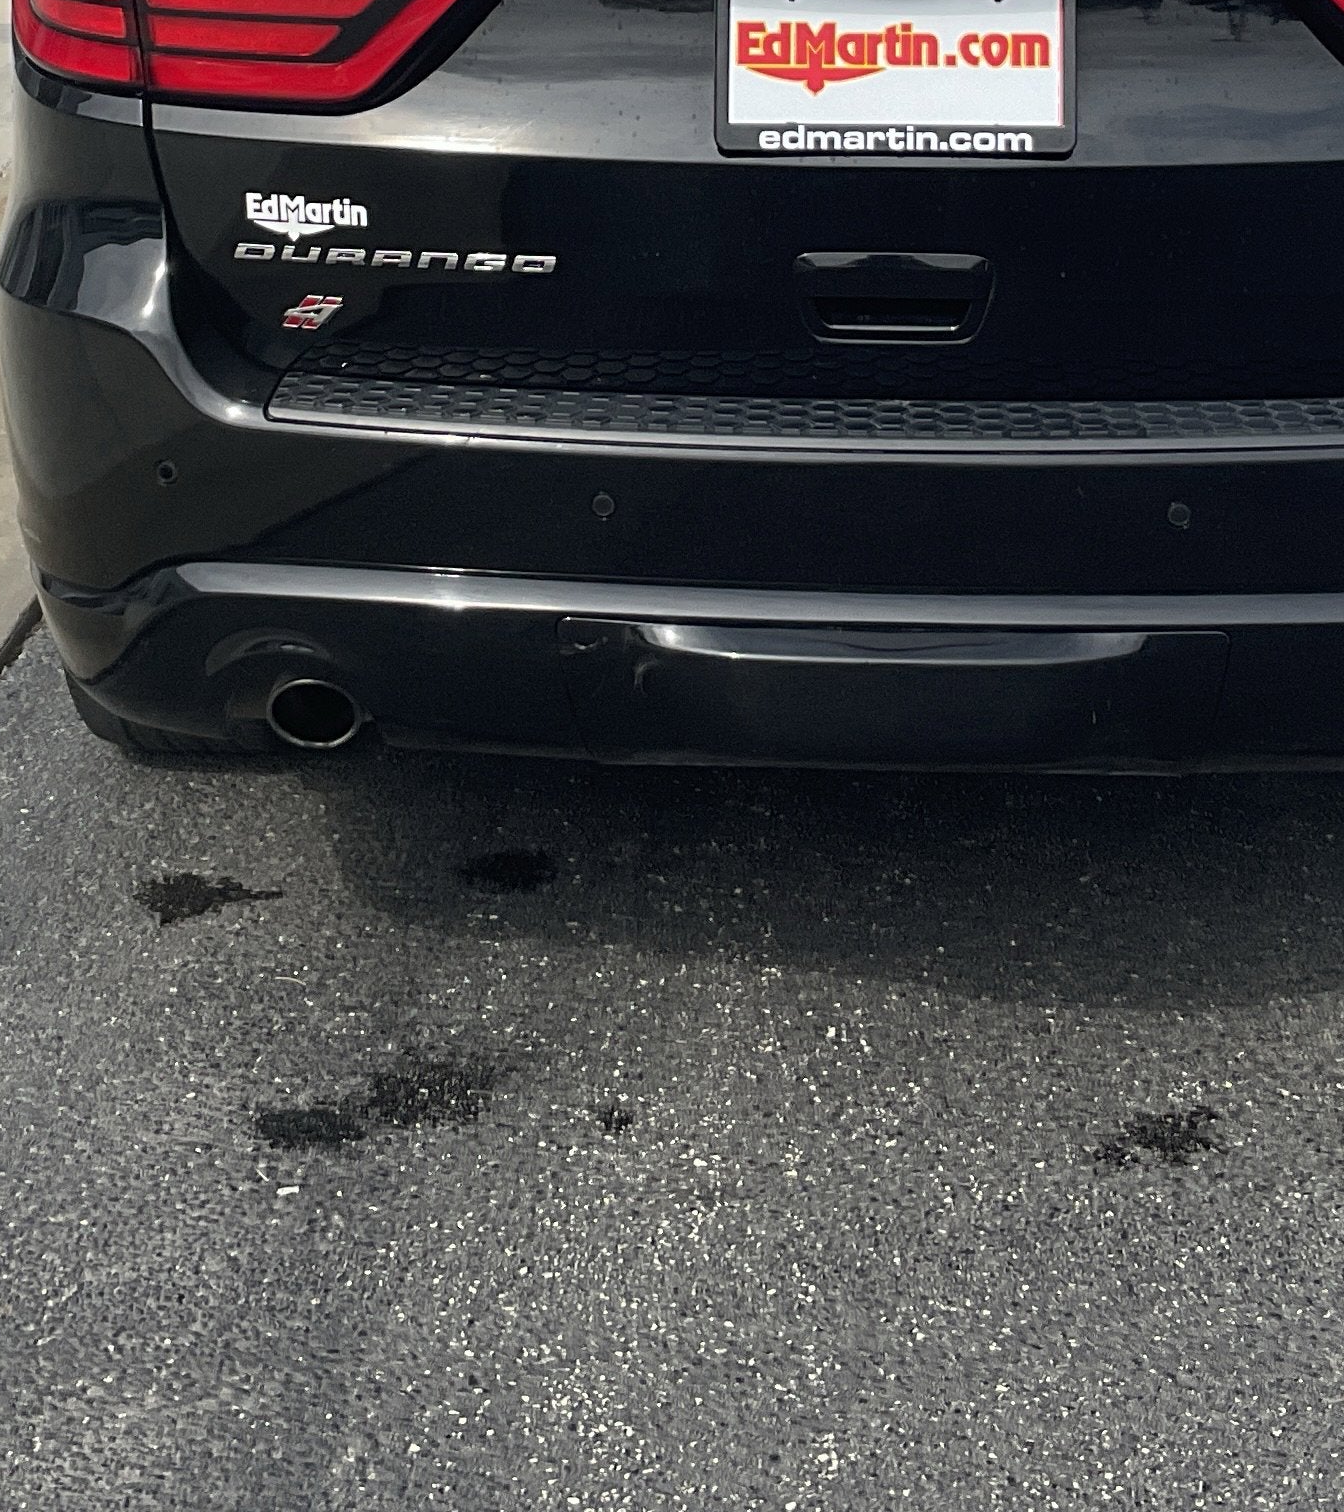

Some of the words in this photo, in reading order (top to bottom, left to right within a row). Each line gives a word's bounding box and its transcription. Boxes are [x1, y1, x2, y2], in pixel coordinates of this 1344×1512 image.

[735, 19, 1053, 70] EdMartin.com
[758, 124, 1034, 153] edmartin.com
[245, 191, 369, 228] EdMartin
[233, 242, 557, 274] DURANGO
